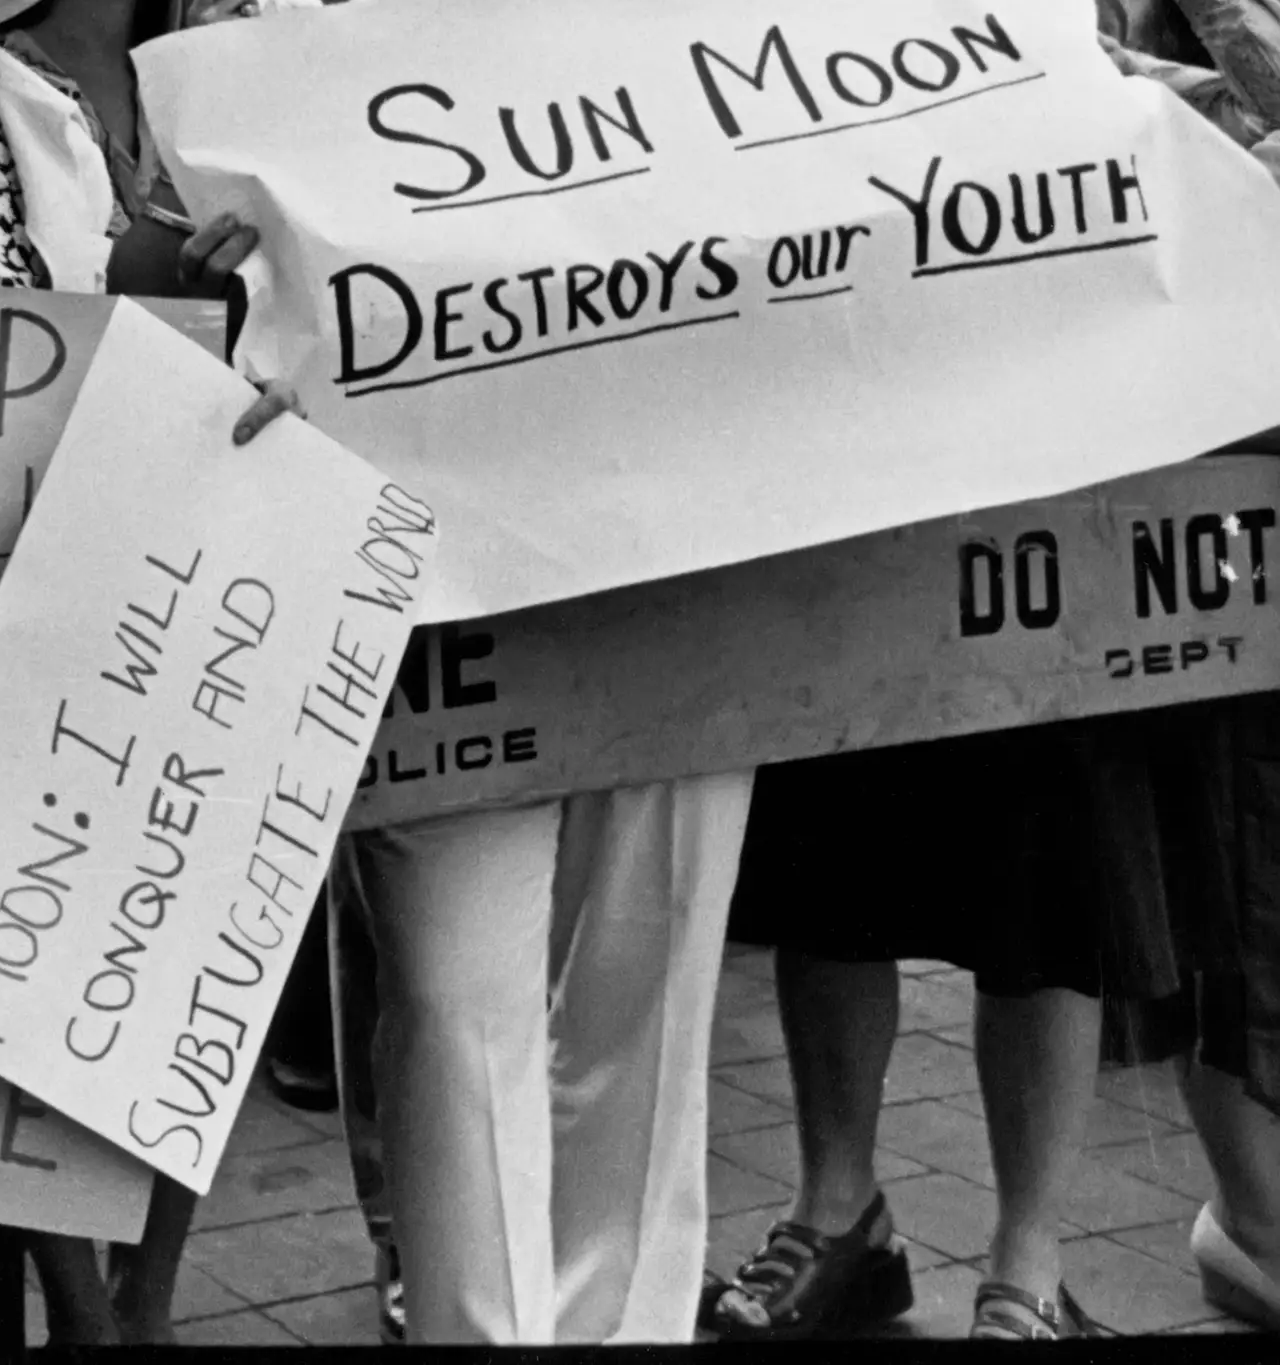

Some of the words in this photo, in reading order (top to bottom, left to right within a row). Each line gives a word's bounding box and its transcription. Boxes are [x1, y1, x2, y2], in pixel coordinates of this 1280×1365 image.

[367, 82, 654, 201] SUN
[689, 12, 1022, 140] MOON
[328, 235, 739, 384] DESTROYS
[867, 155, 1150, 257] YOUTH
[52, 698, 137, 786] I
[100, 547, 203, 698] WILL
[958, 529, 1060, 637] DO
[1132, 507, 1276, 618] NOT
[1105, 635, 1244, 678] DEPT
[294, 618, 385, 747] THE
[65, 750, 226, 1063] CONQUER
[192, 577, 277, 730] AND
